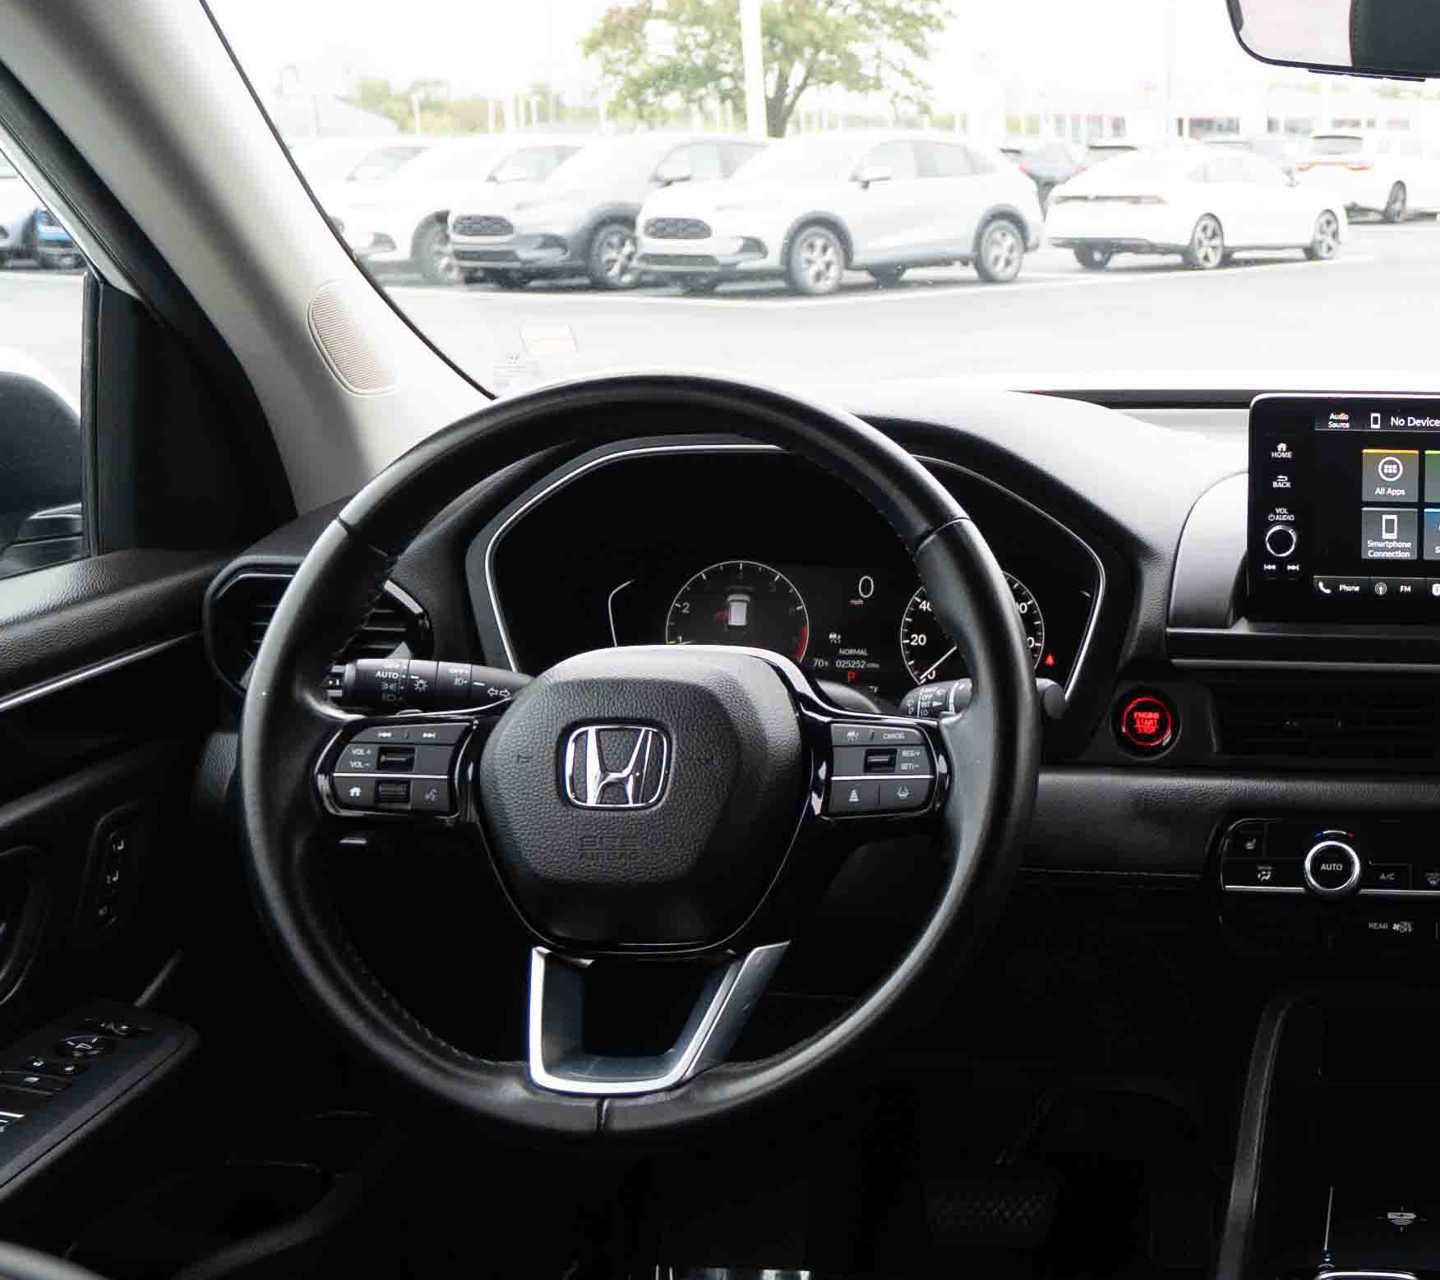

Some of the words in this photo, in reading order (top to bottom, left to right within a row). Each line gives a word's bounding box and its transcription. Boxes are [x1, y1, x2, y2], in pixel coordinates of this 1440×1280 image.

[1390, 416, 1405, 426] No
[1407, 416, 1440, 427] Device
[1271, 451, 1293, 459] HOME
[1272, 481, 1291, 489] BACK
[1374, 487, 1386, 495] All
[1386, 487, 1405, 497] Apps
[1275, 507, 1288, 515] VOL
[1367, 540, 1412, 549] Smartphone
[1367, 549, 1410, 558] Connection
[858, 575, 875, 598] 0
[1339, 583, 1361, 592] Phone
[1400, 585, 1411, 593] FM
[680, 602, 691, 615] 2
[910, 633, 927, 646] 20
[838, 648, 868, 656] NORMAL
[375, 671, 399, 679] AUTO
[1319, 862, 1343, 872] AUTO
[1378, 872, 1396, 881] A/C
[1368, 922, 1389, 930] REAR
